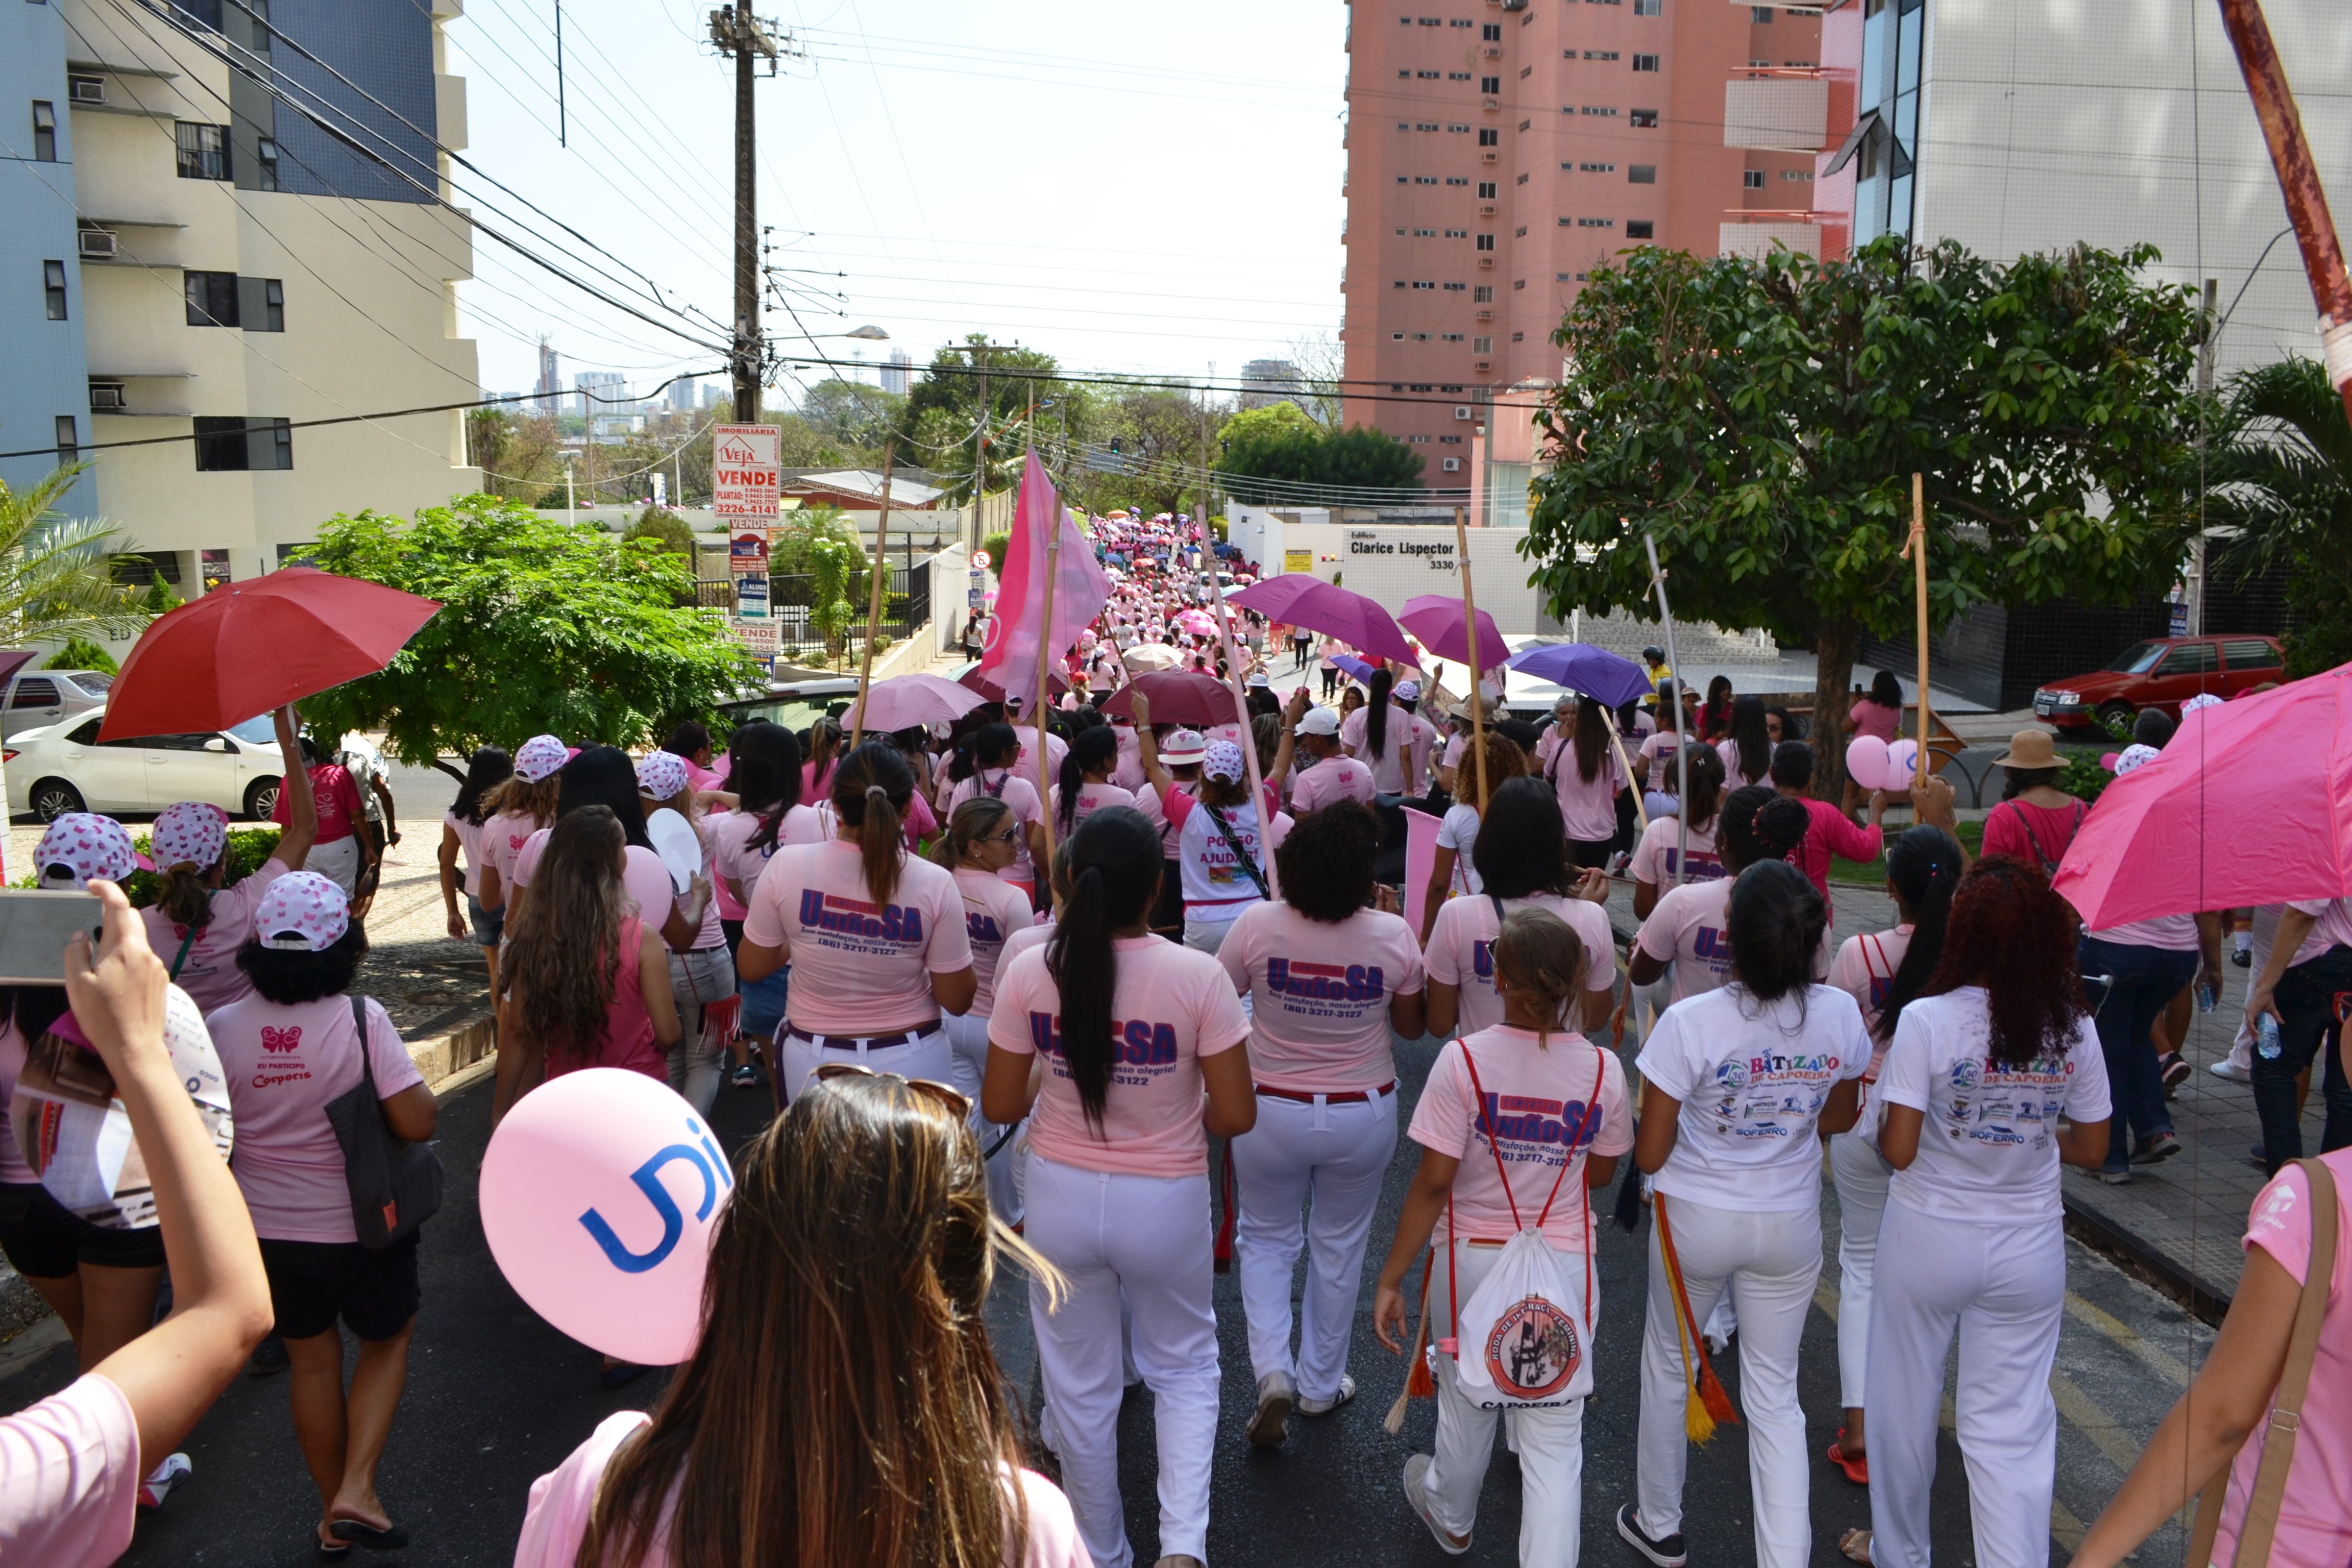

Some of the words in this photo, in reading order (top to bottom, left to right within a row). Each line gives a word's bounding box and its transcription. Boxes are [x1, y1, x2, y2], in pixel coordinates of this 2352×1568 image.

[718, 471, 776, 486] VENDE
[717, 489, 743, 500] PLANTÃO:
[717, 504, 776, 514] 3226-4141
[731, 520, 767, 528] VENDE
[1351, 542, 1393, 554] Clarice
[1400, 542, 1454, 557] Lispector
[1430, 561, 1454, 570] 3330
[819, 938, 840, 949] (86)
[864, 939, 887, 947] nossa
[179, 967, 217, 975] ONCOCENTER
[1269, 990, 1282, 999] Sua
[1284, 995, 1326, 1008] satisfação,
[1284, 1004, 1306, 1014] (86)
[1309, 1008, 1362, 1018] 3217-3122
[1137, 1064, 1177, 1076] alegria!
[1750, 1054, 1840, 1074] BATIZADO
[252, 1071, 312, 1088] Corporis
[1750, 1073, 1765, 1084] DE
[1768, 1071, 1831, 1081] CAPOEIRA
[1984, 1075, 2000, 1084] DE
[2003, 1074, 2067, 1084] CAPOEIRA
[1502, 1097, 1560, 1112] COMERCIAL
[1735, 1127, 1787, 1137] SOFERRO
[1969, 1131, 2025, 1144] SOFERRO
[1475, 1132, 1488, 1145] Sua
[1539, 1145, 1564, 1156] nossa
[1492, 1334, 1503, 1360] RODA
[1501, 1319, 1513, 1333] DE
[1553, 1315, 1576, 1359] FEMININA
[1481, 1399, 1573, 1409] CAPOEIRA
